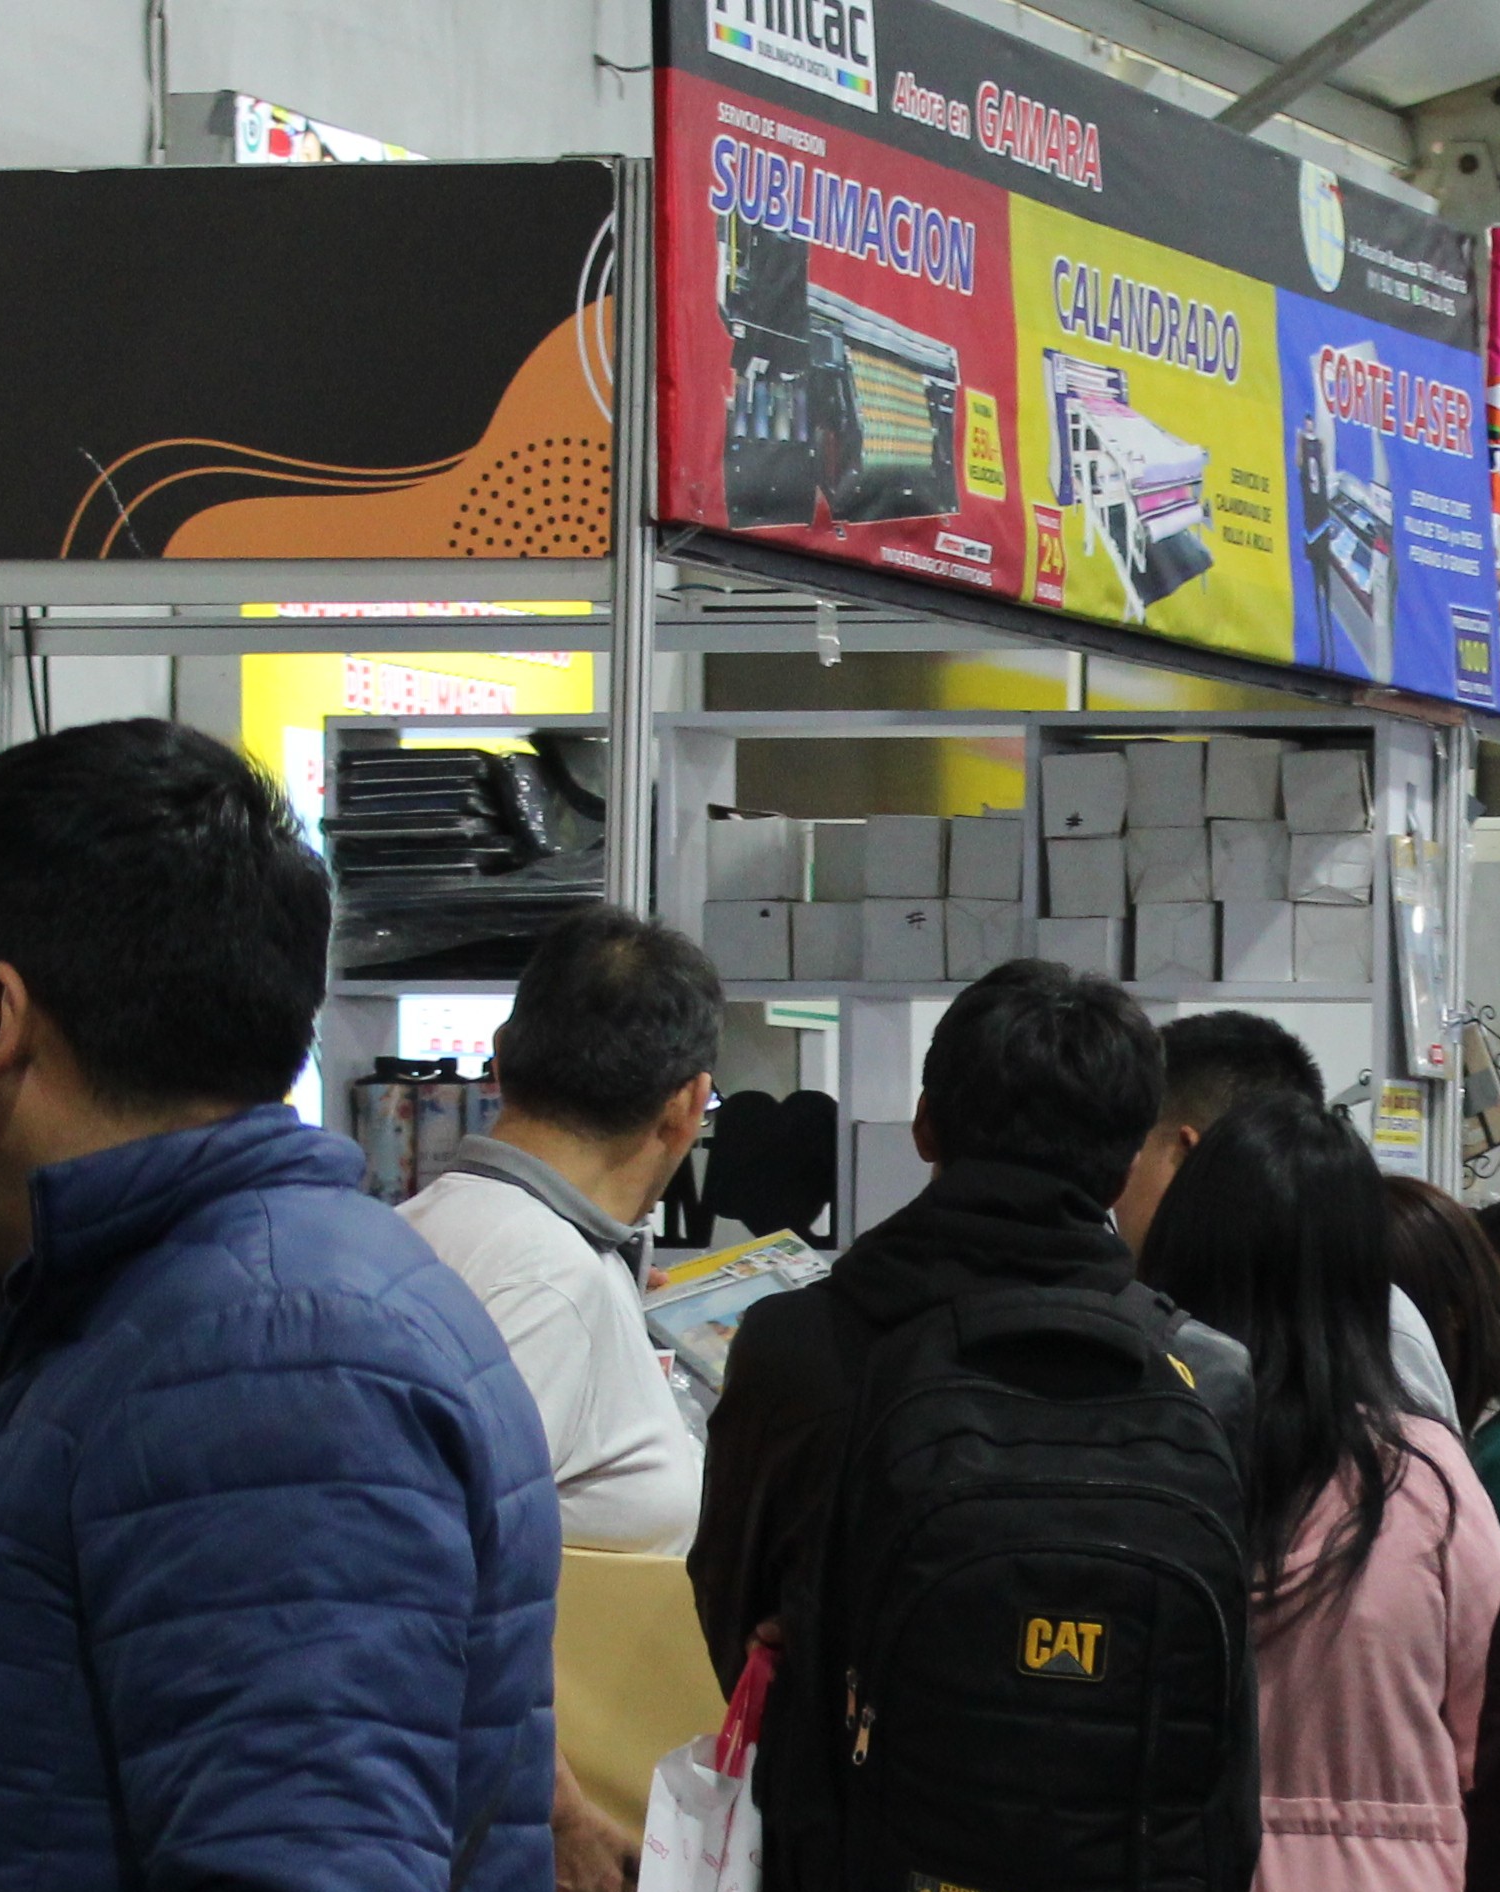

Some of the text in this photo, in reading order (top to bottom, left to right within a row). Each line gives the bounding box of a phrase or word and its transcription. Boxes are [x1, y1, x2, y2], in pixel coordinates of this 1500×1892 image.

[717, 101, 762, 136] SERVICIO
[761, 116, 776, 140] DE
[893, 70, 1103, 193] Ahora en GAMARA
[709, 134, 975, 296] SUBLIMACION
[1053, 255, 1241, 386] CALANDRADO
[1319, 344, 1473, 458] CORTE LASER
[1041, 533, 1063, 575] 24
[343, 655, 374, 715] DE
[1025, 1618, 1102, 1675] CAT
